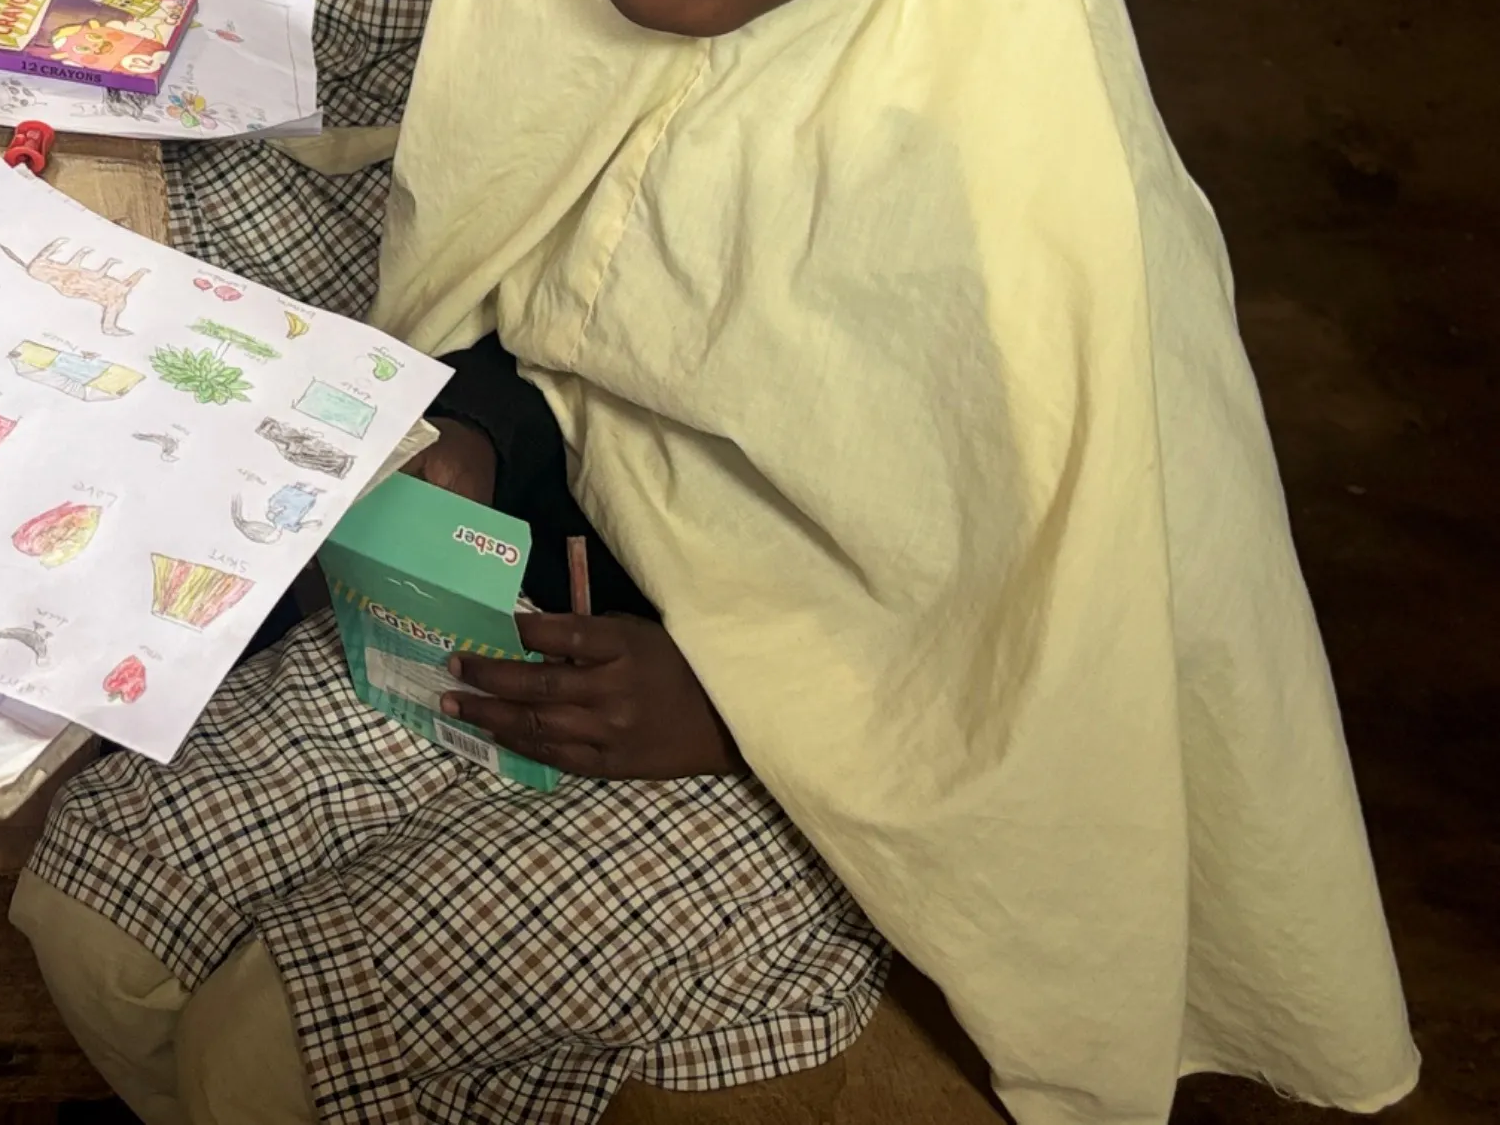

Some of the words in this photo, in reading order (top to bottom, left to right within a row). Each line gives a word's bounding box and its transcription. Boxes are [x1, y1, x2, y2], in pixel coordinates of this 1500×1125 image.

[20, 61, 38, 72] 12
[40, 64, 102, 83] CRAYONS
[128, 54, 153, 72] 12
[453, 525, 520, 566] Casber
